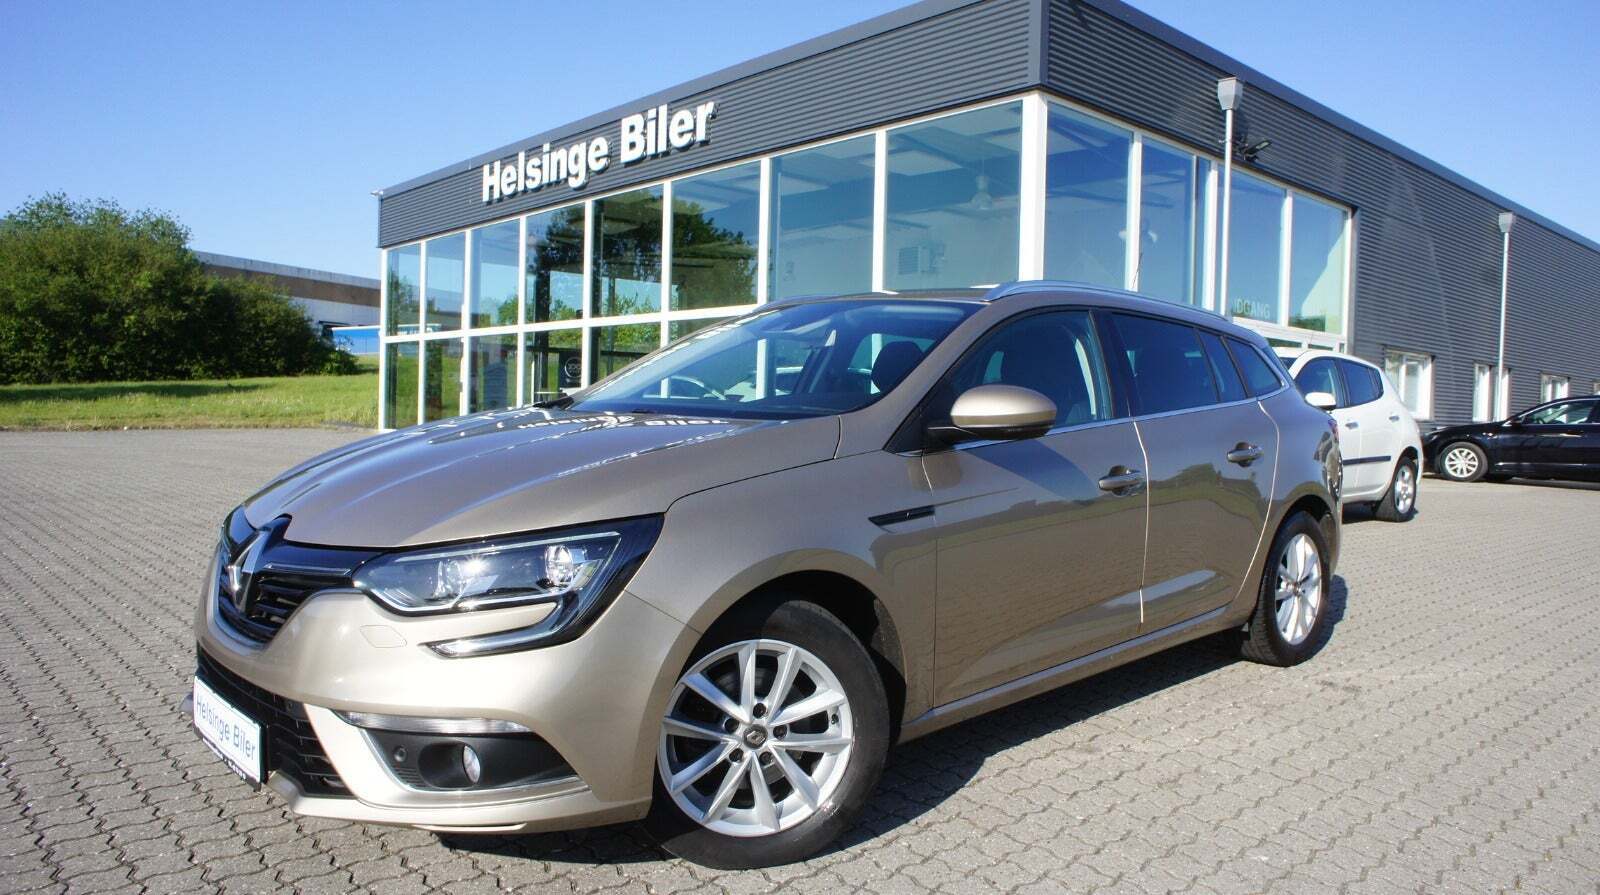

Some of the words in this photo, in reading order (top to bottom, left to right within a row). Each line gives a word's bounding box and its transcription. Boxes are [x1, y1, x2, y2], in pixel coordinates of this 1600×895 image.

[482, 136, 611, 202] Helsinge
[621, 101, 716, 164] Biler
[196, 695, 230, 742] Helsinge
[233, 725, 256, 760] Biler
